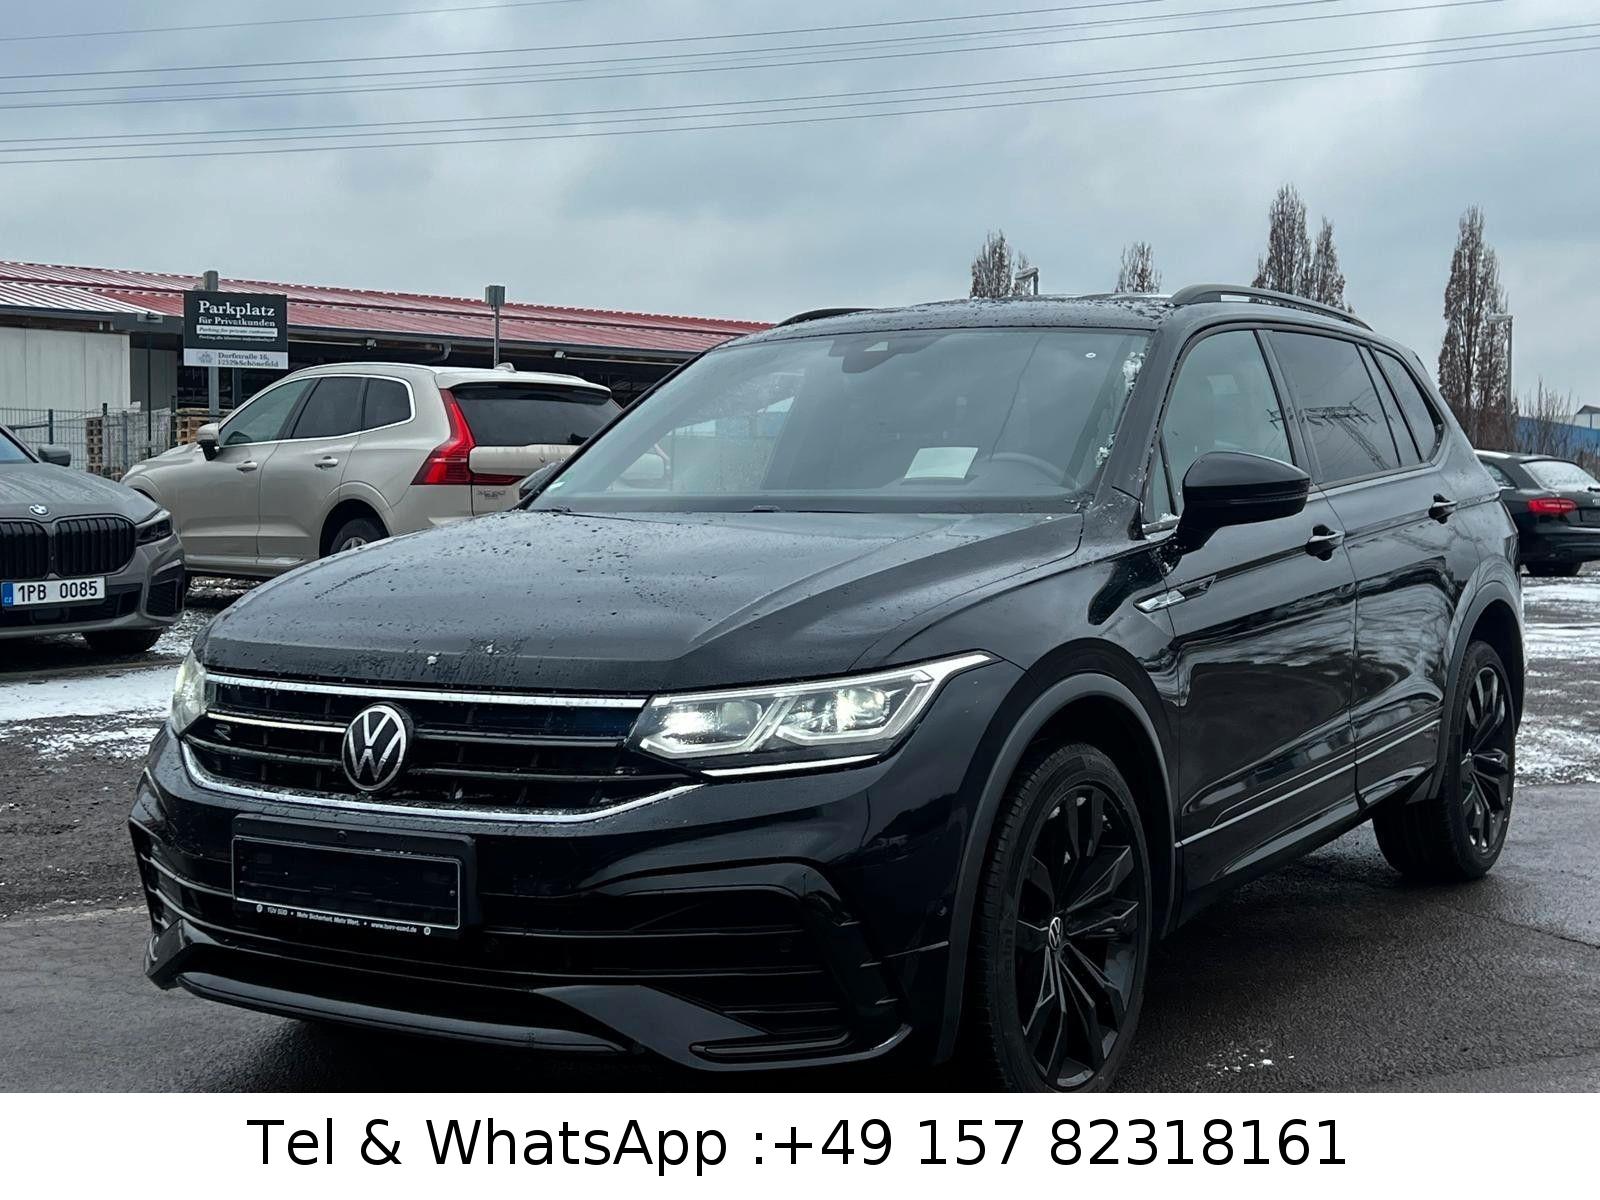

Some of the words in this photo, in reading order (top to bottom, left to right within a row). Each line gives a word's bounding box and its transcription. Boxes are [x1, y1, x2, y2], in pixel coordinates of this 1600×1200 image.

[198, 300, 275, 318] Parkplatz
[198, 316, 212, 324] für
[214, 317, 275, 327] Privatkunden
[18, 584, 47, 602] 1PB
[59, 581, 98, 599] 0085
